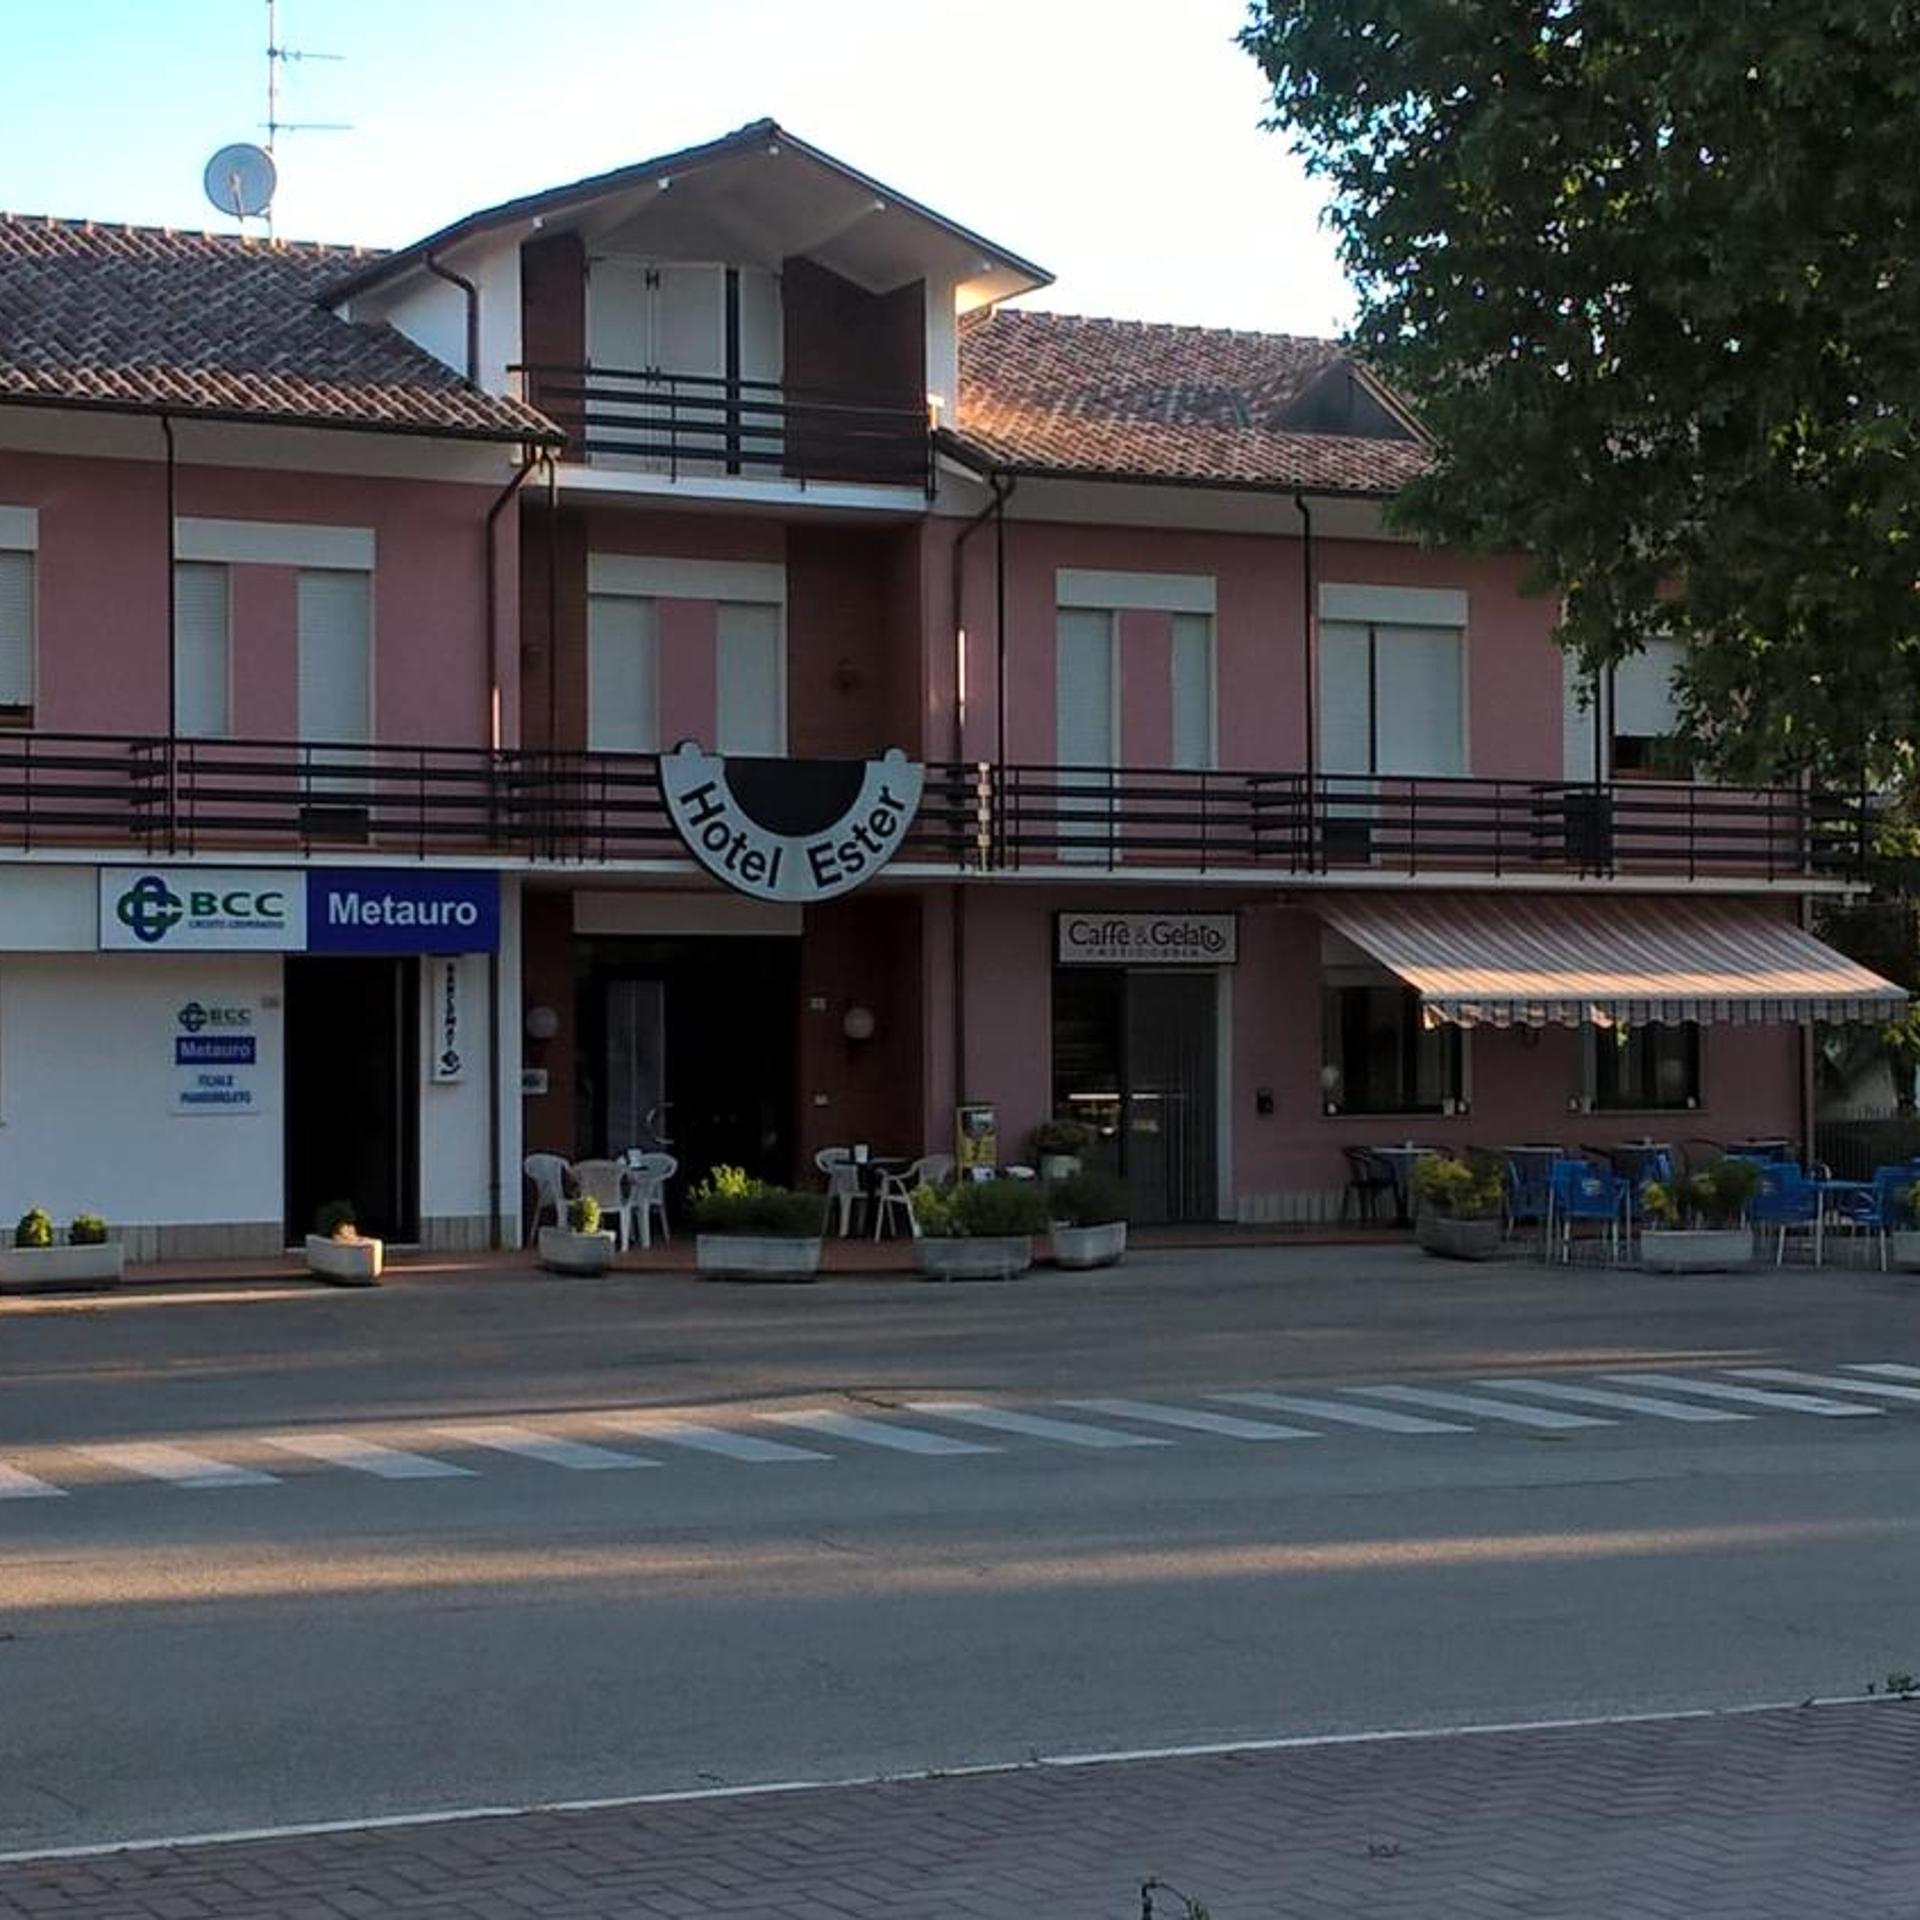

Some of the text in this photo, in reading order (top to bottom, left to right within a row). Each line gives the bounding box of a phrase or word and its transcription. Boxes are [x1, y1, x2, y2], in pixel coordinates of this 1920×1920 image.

[679, 781, 905, 888] Hotel Ester
[190, 892, 284, 917] BCC
[328, 892, 478, 926] Metauro
[1151, 921, 1223, 949] Gelato
[181, 1040, 250, 1057] Metauro
